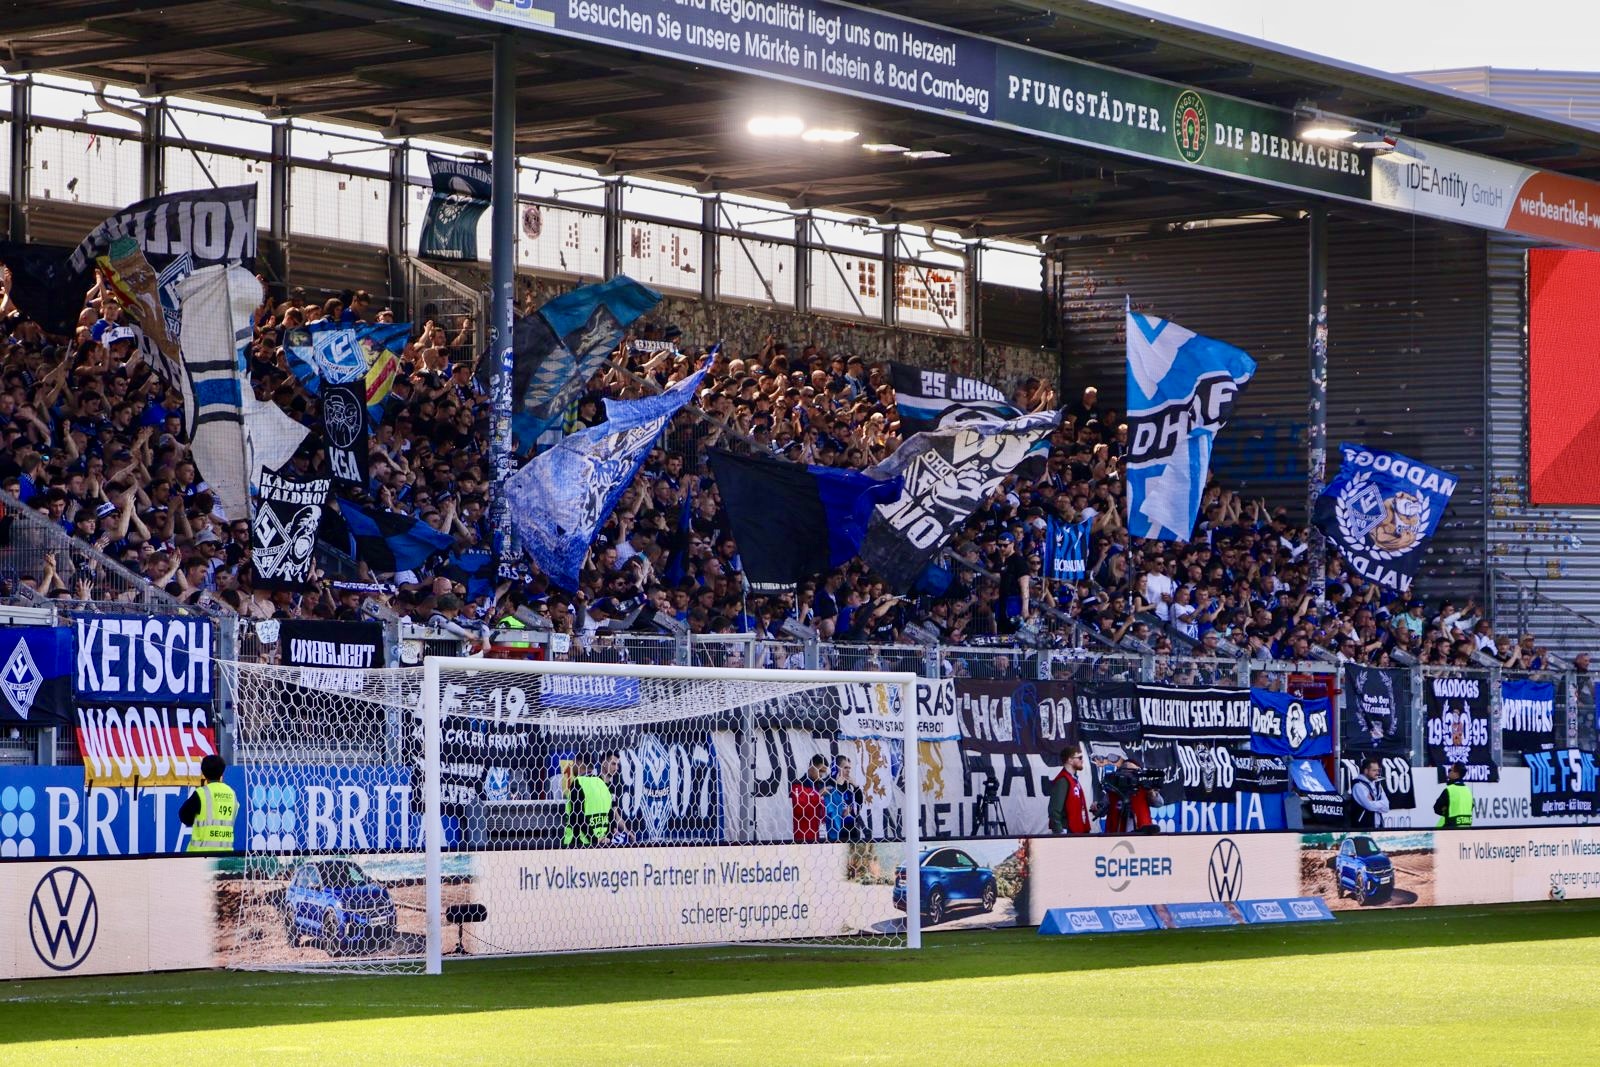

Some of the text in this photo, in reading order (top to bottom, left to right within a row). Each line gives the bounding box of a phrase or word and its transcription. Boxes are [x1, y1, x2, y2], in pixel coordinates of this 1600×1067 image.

[808, 10, 841, 44] liegt
[845, 24, 870, 47] uns
[874, 31, 898, 53] am
[902, 32, 956, 67] Herzen!
[569, 0, 989, 114] Besuchen Sie unsere Märkte in Idstein & Bad Camberg
[1008, 75, 1167, 133] PFUNGSTÄDTER.
[1215, 123, 1366, 177] DIE BIERMACHER.
[1471, 183, 1503, 208] GmbH
[920, 371, 946, 398] 25
[77, 618, 210, 694] KETSCH
[1433, 678, 1479, 698] MADDOGS
[1140, 698, 1190, 729] KOLLEKTIV
[1191, 699, 1225, 728] SECHS
[77, 706, 210, 778] WOODLES
[1525, 751, 1557, 794] DIE
[218, 805, 233, 817] 499
[1459, 842, 1472, 860] Ihr
[1474, 841, 1527, 863] Volkswagen
[1528, 840, 1559, 858] Partner
[1561, 839, 1570, 856] in
[519, 860, 801, 893] Ihr Volkswagen Partner in Wiesbaden
[681, 901, 809, 929] scherer-gruppe.de
[1080, 913, 1099, 925] PLAN
[1122, 912, 1141, 924] PLAN
